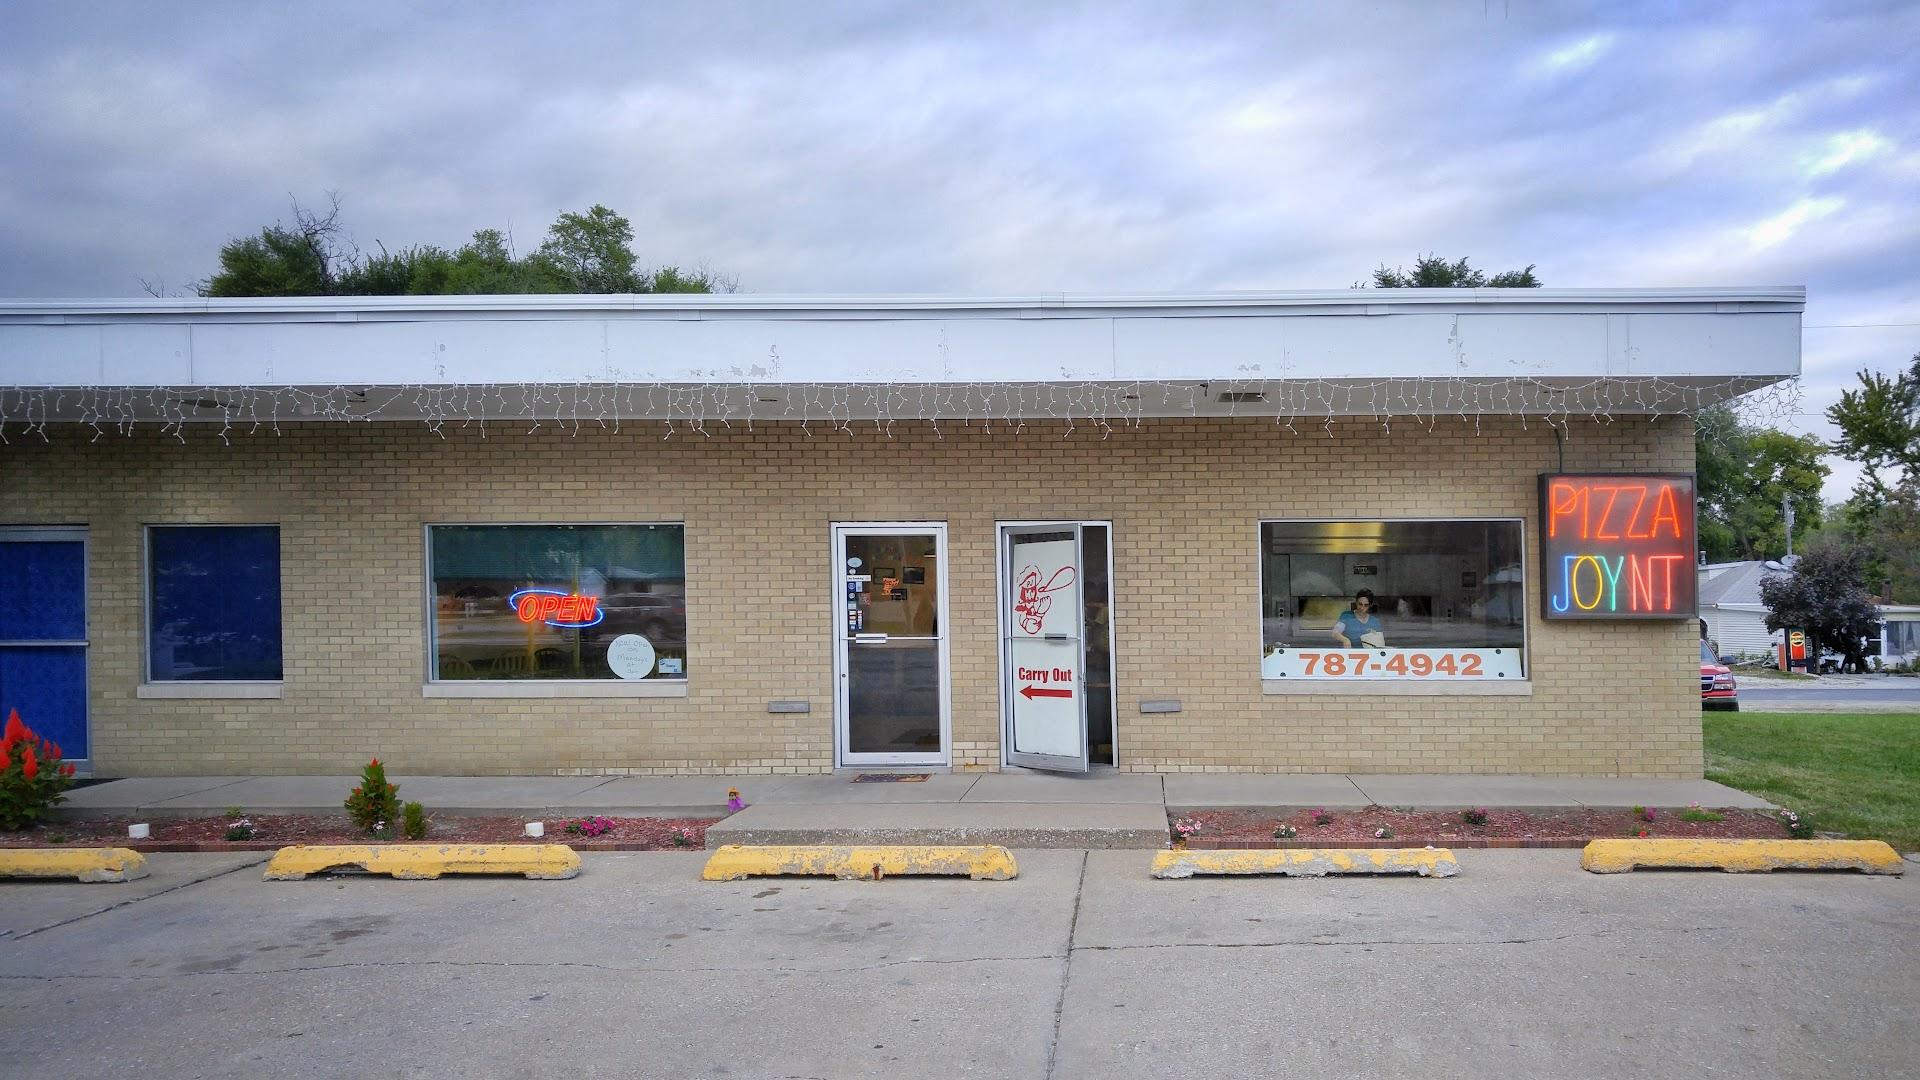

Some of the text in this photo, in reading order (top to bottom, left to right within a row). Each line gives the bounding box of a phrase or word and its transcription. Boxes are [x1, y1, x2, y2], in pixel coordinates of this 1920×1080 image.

[1550, 484, 1681, 539] PIZZA
[1552, 554, 1684, 612] JOYNT
[518, 595, 598, 623] OPEN
[1019, 667, 1072, 683] Carry Out
[1299, 653, 1484, 677] 787-4942
